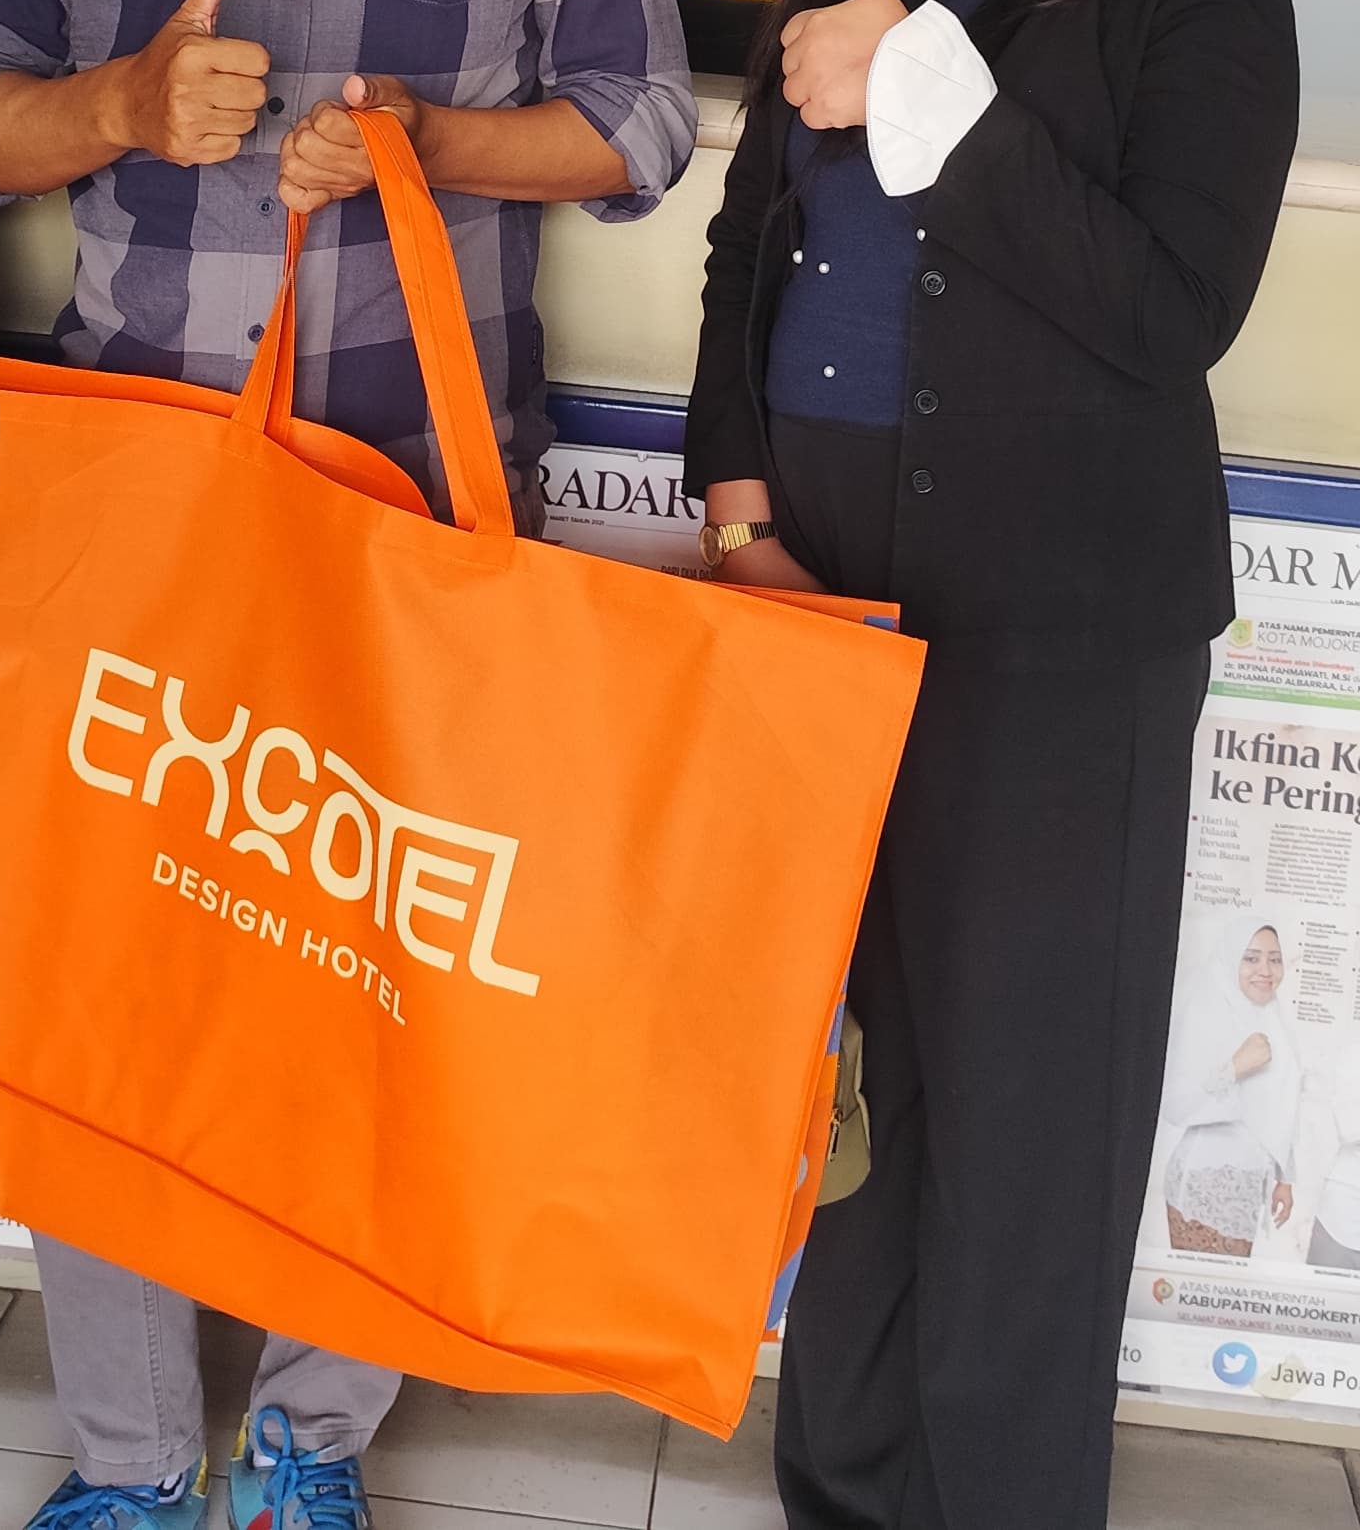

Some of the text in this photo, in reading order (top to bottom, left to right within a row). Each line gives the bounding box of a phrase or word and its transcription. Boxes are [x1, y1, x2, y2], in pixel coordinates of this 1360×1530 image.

[539, 465, 699, 519] RADAR
[1231, 542, 1316, 587] DAR
[1257, 632, 1296, 646] KOTA
[1284, 624, 1309, 633] NAMA
[1224, 672, 1282, 685] MUHAMMAD
[1238, 663, 1268, 673] IKFINA
[1213, 729, 1320, 769] Ikfina
[1211, 771, 1253, 803] ke
[67, 648, 540, 997] EXCOTEL
[1201, 815, 1226, 826] Hari
[1200, 826, 1238, 838] Dilantik
[1199, 837, 1240, 850] Bersama
[152, 852, 406, 1026] DESIGN HOTEL
[1178, 1294, 1271, 1314] KABUPATEN
[1180, 1281, 1326, 1306] ATAS NAMA PEMERINTAH
[1271, 1363, 1325, 1387] Jawa
